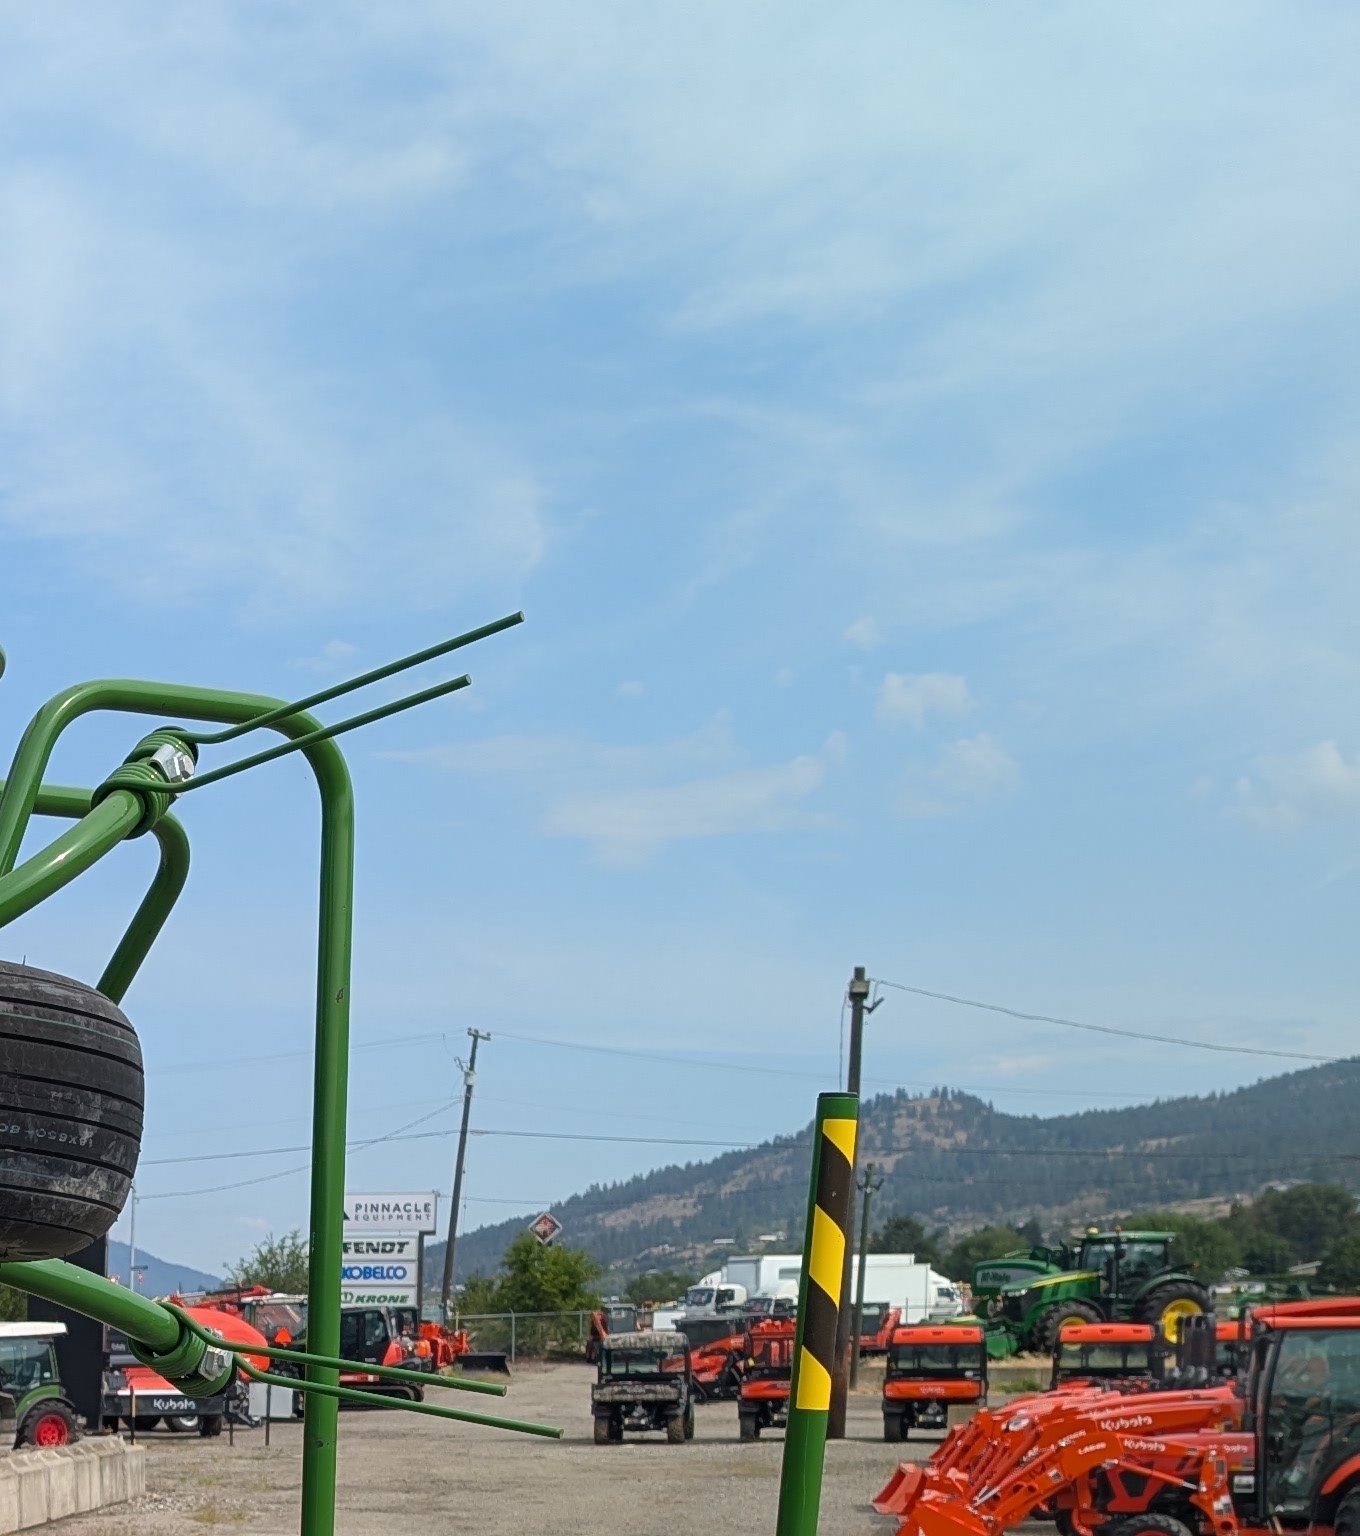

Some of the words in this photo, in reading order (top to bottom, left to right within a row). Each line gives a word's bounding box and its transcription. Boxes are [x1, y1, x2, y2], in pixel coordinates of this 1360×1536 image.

[354, 1202, 432, 1213] PINNACLE
[354, 1213, 431, 1221] EQUIPMENT
[342, 1241, 410, 1254] FENDT
[341, 1265, 407, 1280] KOBELCO
[355, 1294, 410, 1304] KRONE
[153, 1398, 196, 1410] Kubota
[1100, 1415, 1153, 1431] Kubota
[1123, 1438, 1166, 1452] Kubota
